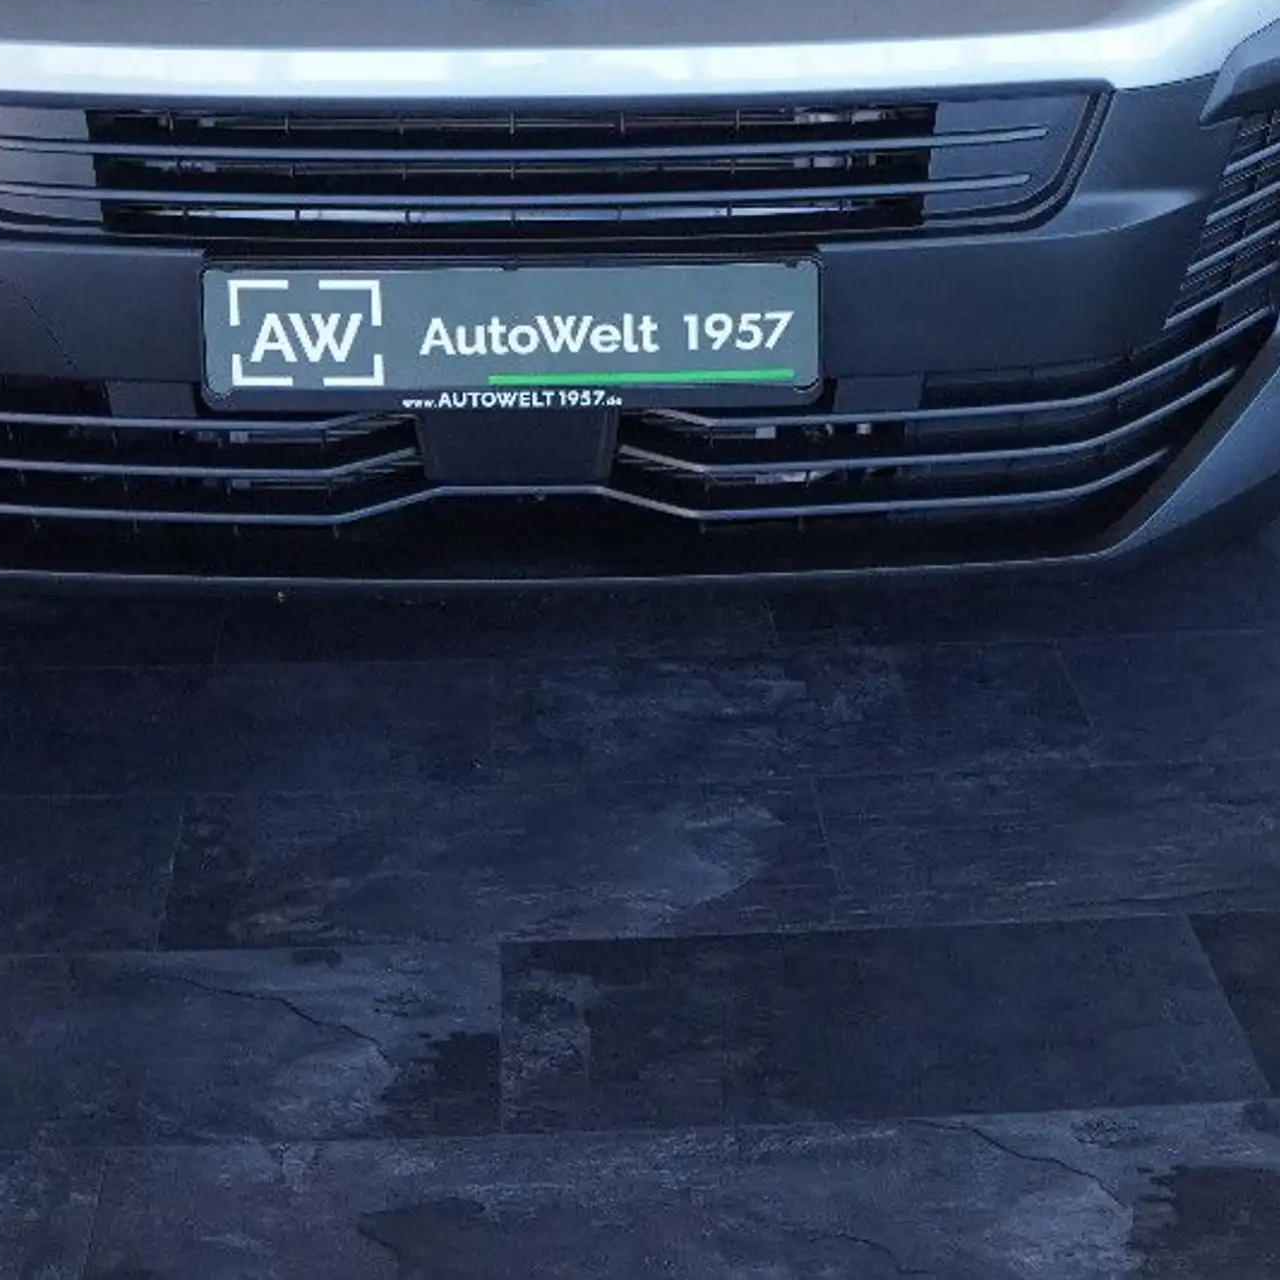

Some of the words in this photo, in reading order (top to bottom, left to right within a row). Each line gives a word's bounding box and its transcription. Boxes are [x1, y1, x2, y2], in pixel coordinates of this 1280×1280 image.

[250, 313, 362, 363] AW
[419, 313, 658, 357] AutoWelt
[682, 311, 795, 351] 1957
